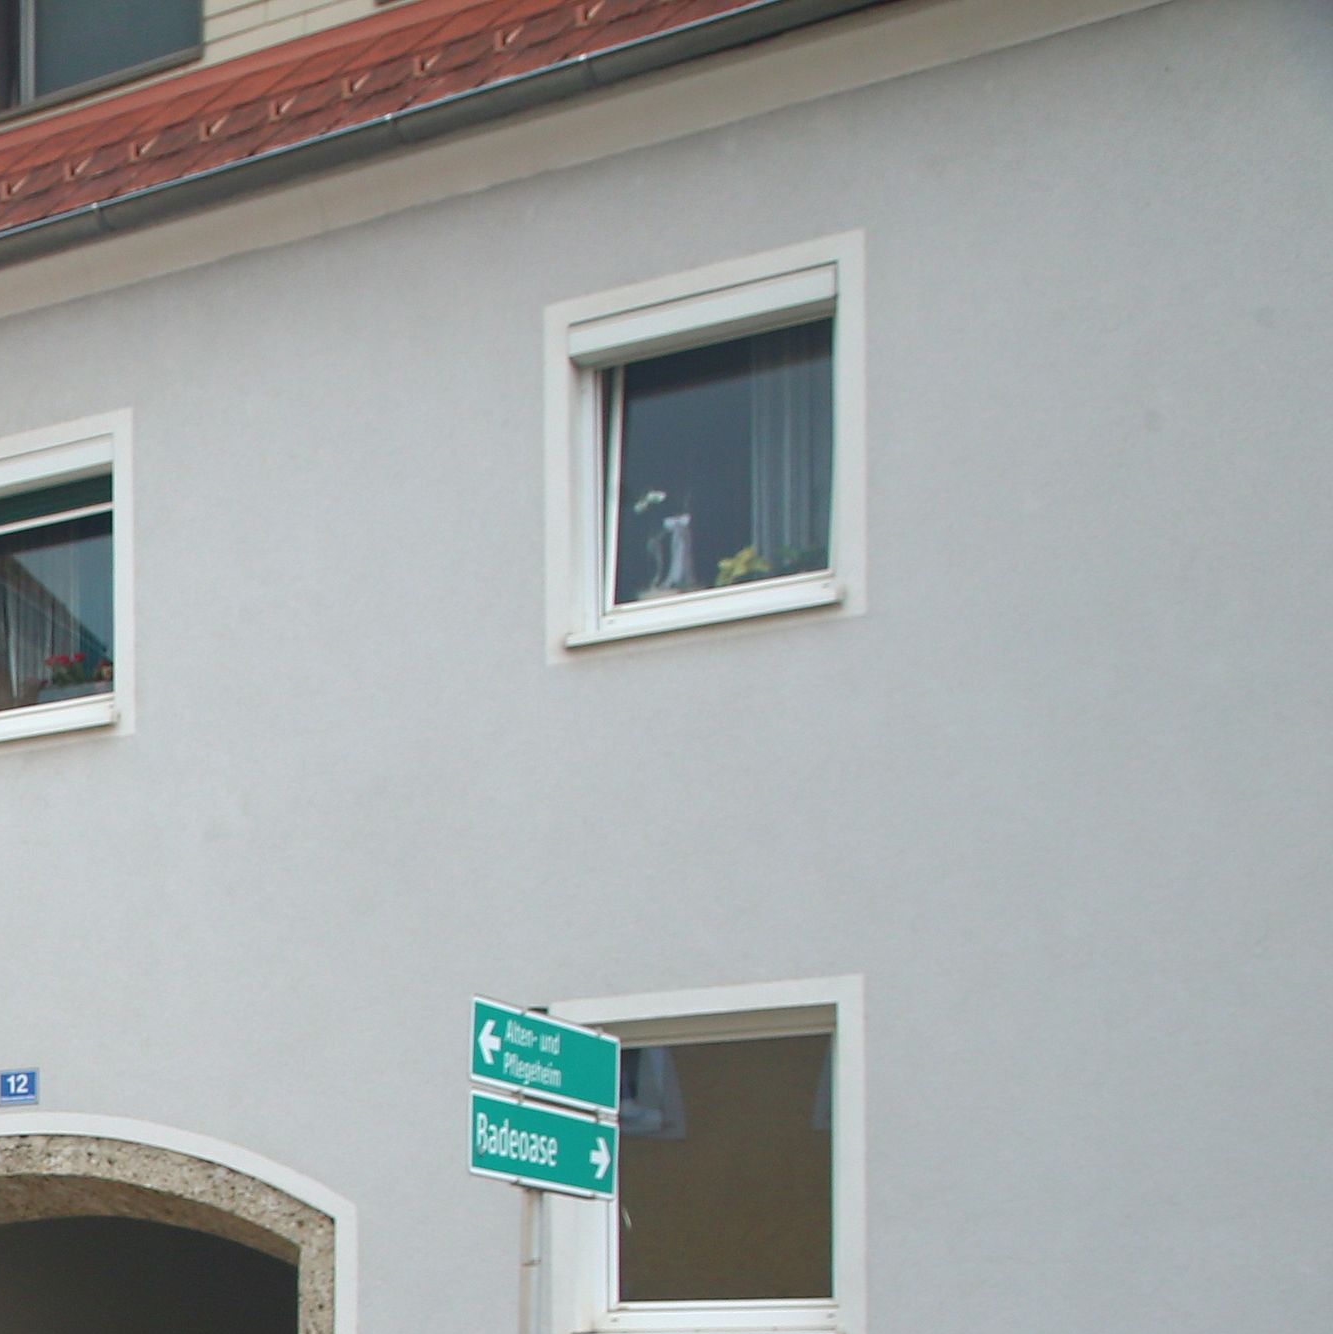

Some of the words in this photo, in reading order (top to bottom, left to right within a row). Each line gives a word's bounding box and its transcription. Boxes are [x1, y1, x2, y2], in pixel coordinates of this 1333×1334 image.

[503, 1019, 538, 1048] Alten-
[539, 1033, 561, 1055] und
[6, 1073, 29, 1094] 12
[502, 1051, 563, 1086] Pflegeheim
[476, 1112, 558, 1168] Badeoase
